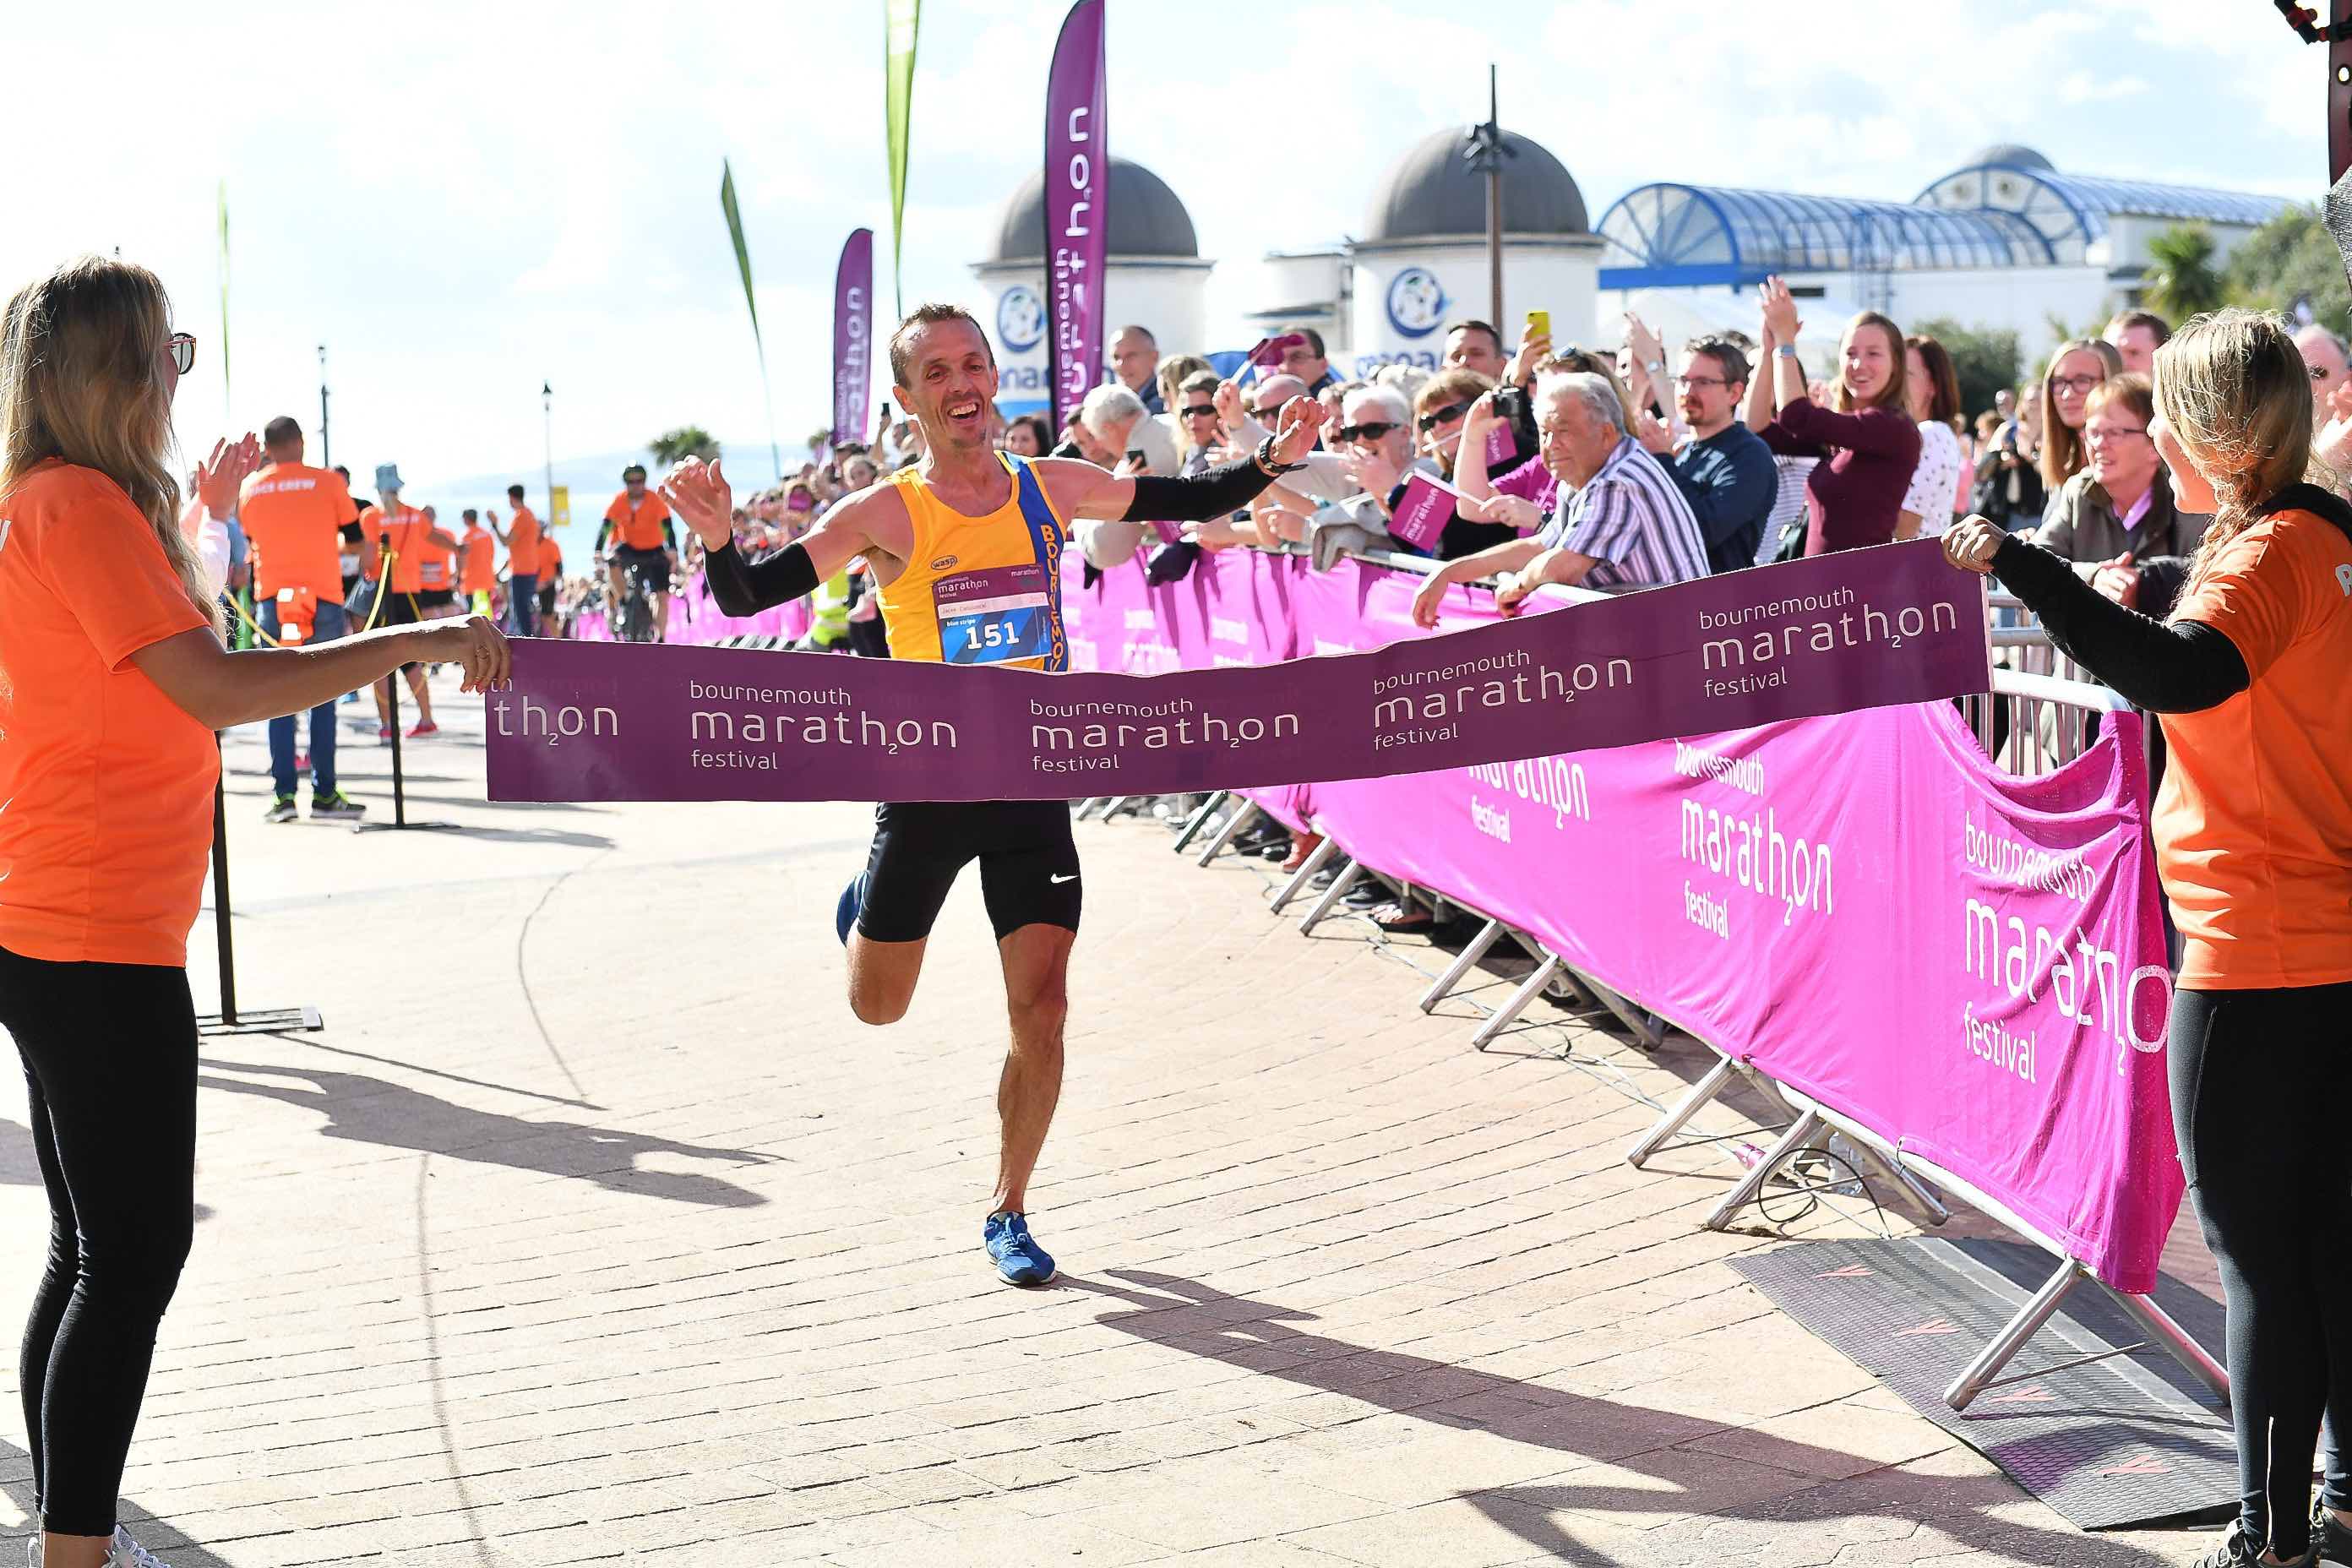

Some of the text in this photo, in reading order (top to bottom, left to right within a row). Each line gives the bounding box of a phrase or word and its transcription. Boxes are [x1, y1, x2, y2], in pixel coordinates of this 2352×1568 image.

[1700, 585, 1854, 629] bournemouth
[966, 622, 1020, 650] 151
[1374, 649, 1530, 695] bournemouth
[1703, 666, 1788, 698] festival
[689, 680, 852, 706] bournemouth
[1030, 698, 1193, 717] bournemouth
[1374, 722, 1459, 751] festival
[690, 749, 778, 770] festival
[1032, 754, 1120, 773] festival
[1674, 737, 1764, 798] bournemouth
[1964, 810, 2097, 903] bournemouth
[1684, 879, 1730, 941] festival
[1963, 1000, 2036, 1083] festival
